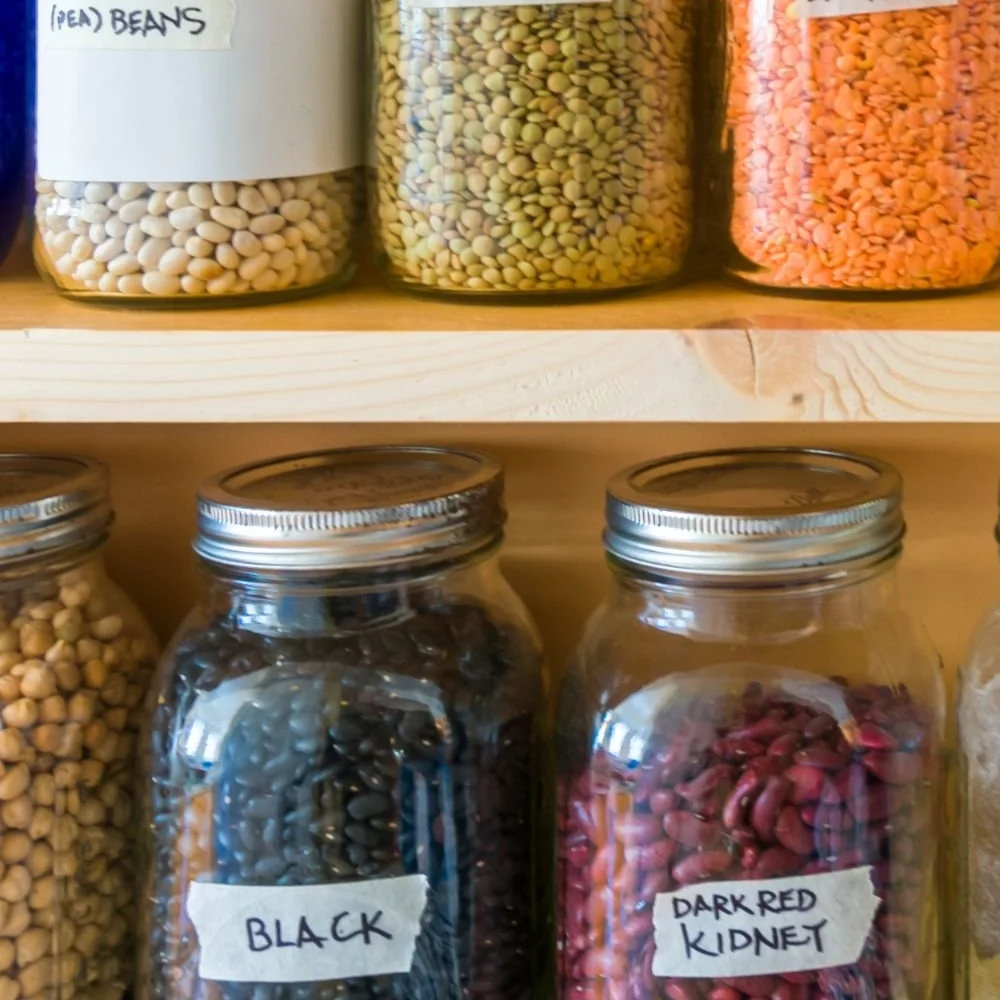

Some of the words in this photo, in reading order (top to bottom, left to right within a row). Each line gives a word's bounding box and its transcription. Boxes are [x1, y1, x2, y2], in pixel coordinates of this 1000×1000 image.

[50, 7, 103, 33] (PEA)
[110, 7, 207, 37] BEANS
[671, 893, 755, 921] DARK
[756, 888, 818, 917] RED
[246, 910, 394, 952] BLACK
[680, 918, 828, 959] KIDNEY
